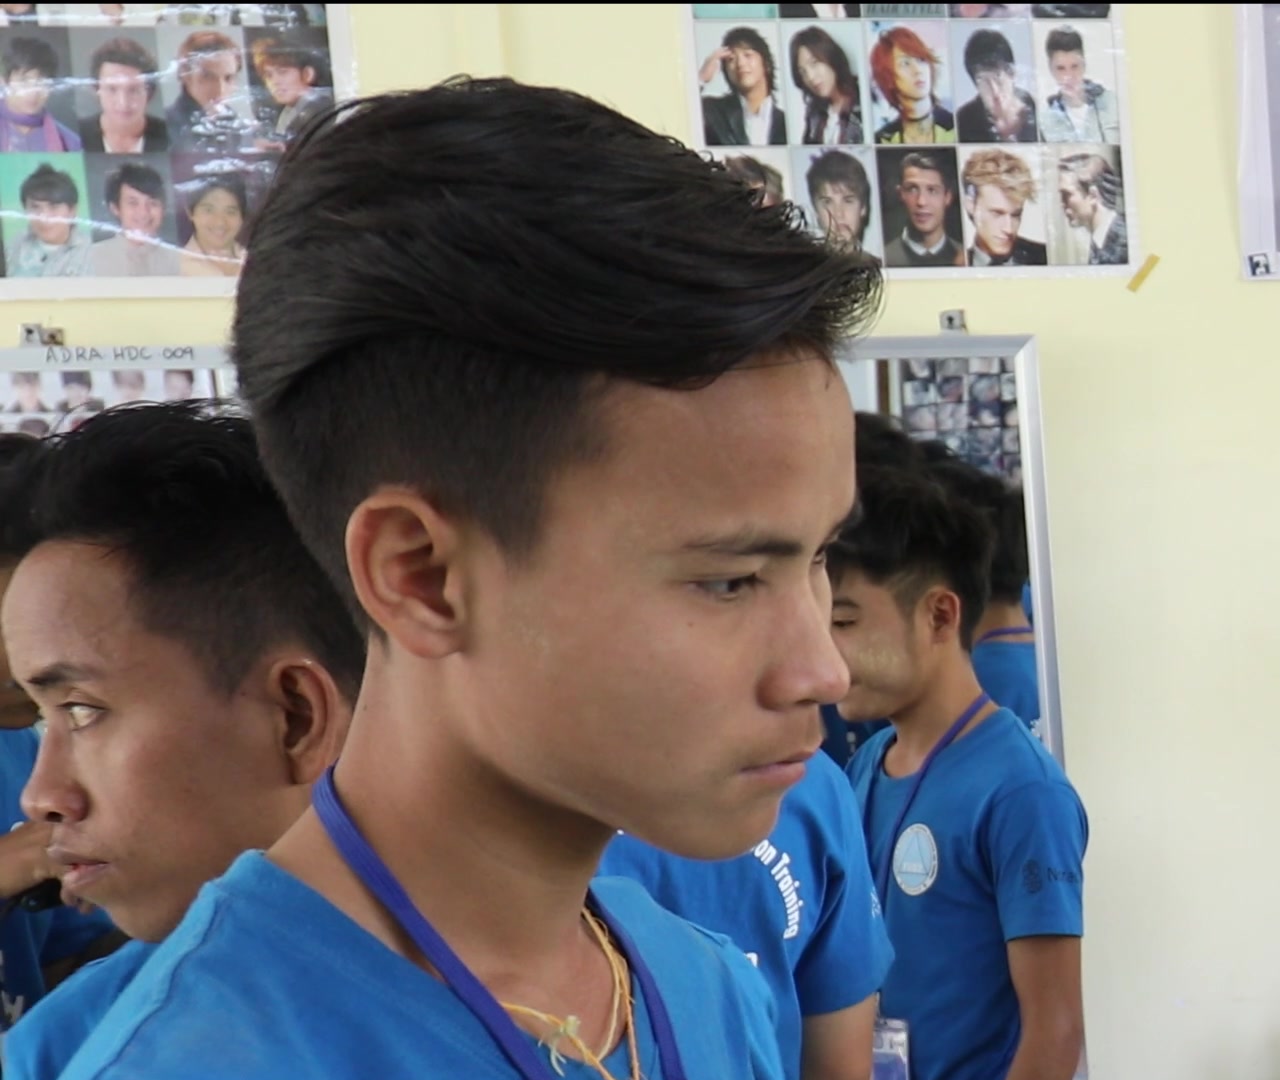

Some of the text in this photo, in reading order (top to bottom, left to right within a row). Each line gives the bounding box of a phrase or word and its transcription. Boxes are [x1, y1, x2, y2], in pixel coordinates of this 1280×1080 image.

[46, 346, 195, 363] ADRA HDC 009
[770, 852, 804, 939] Training
